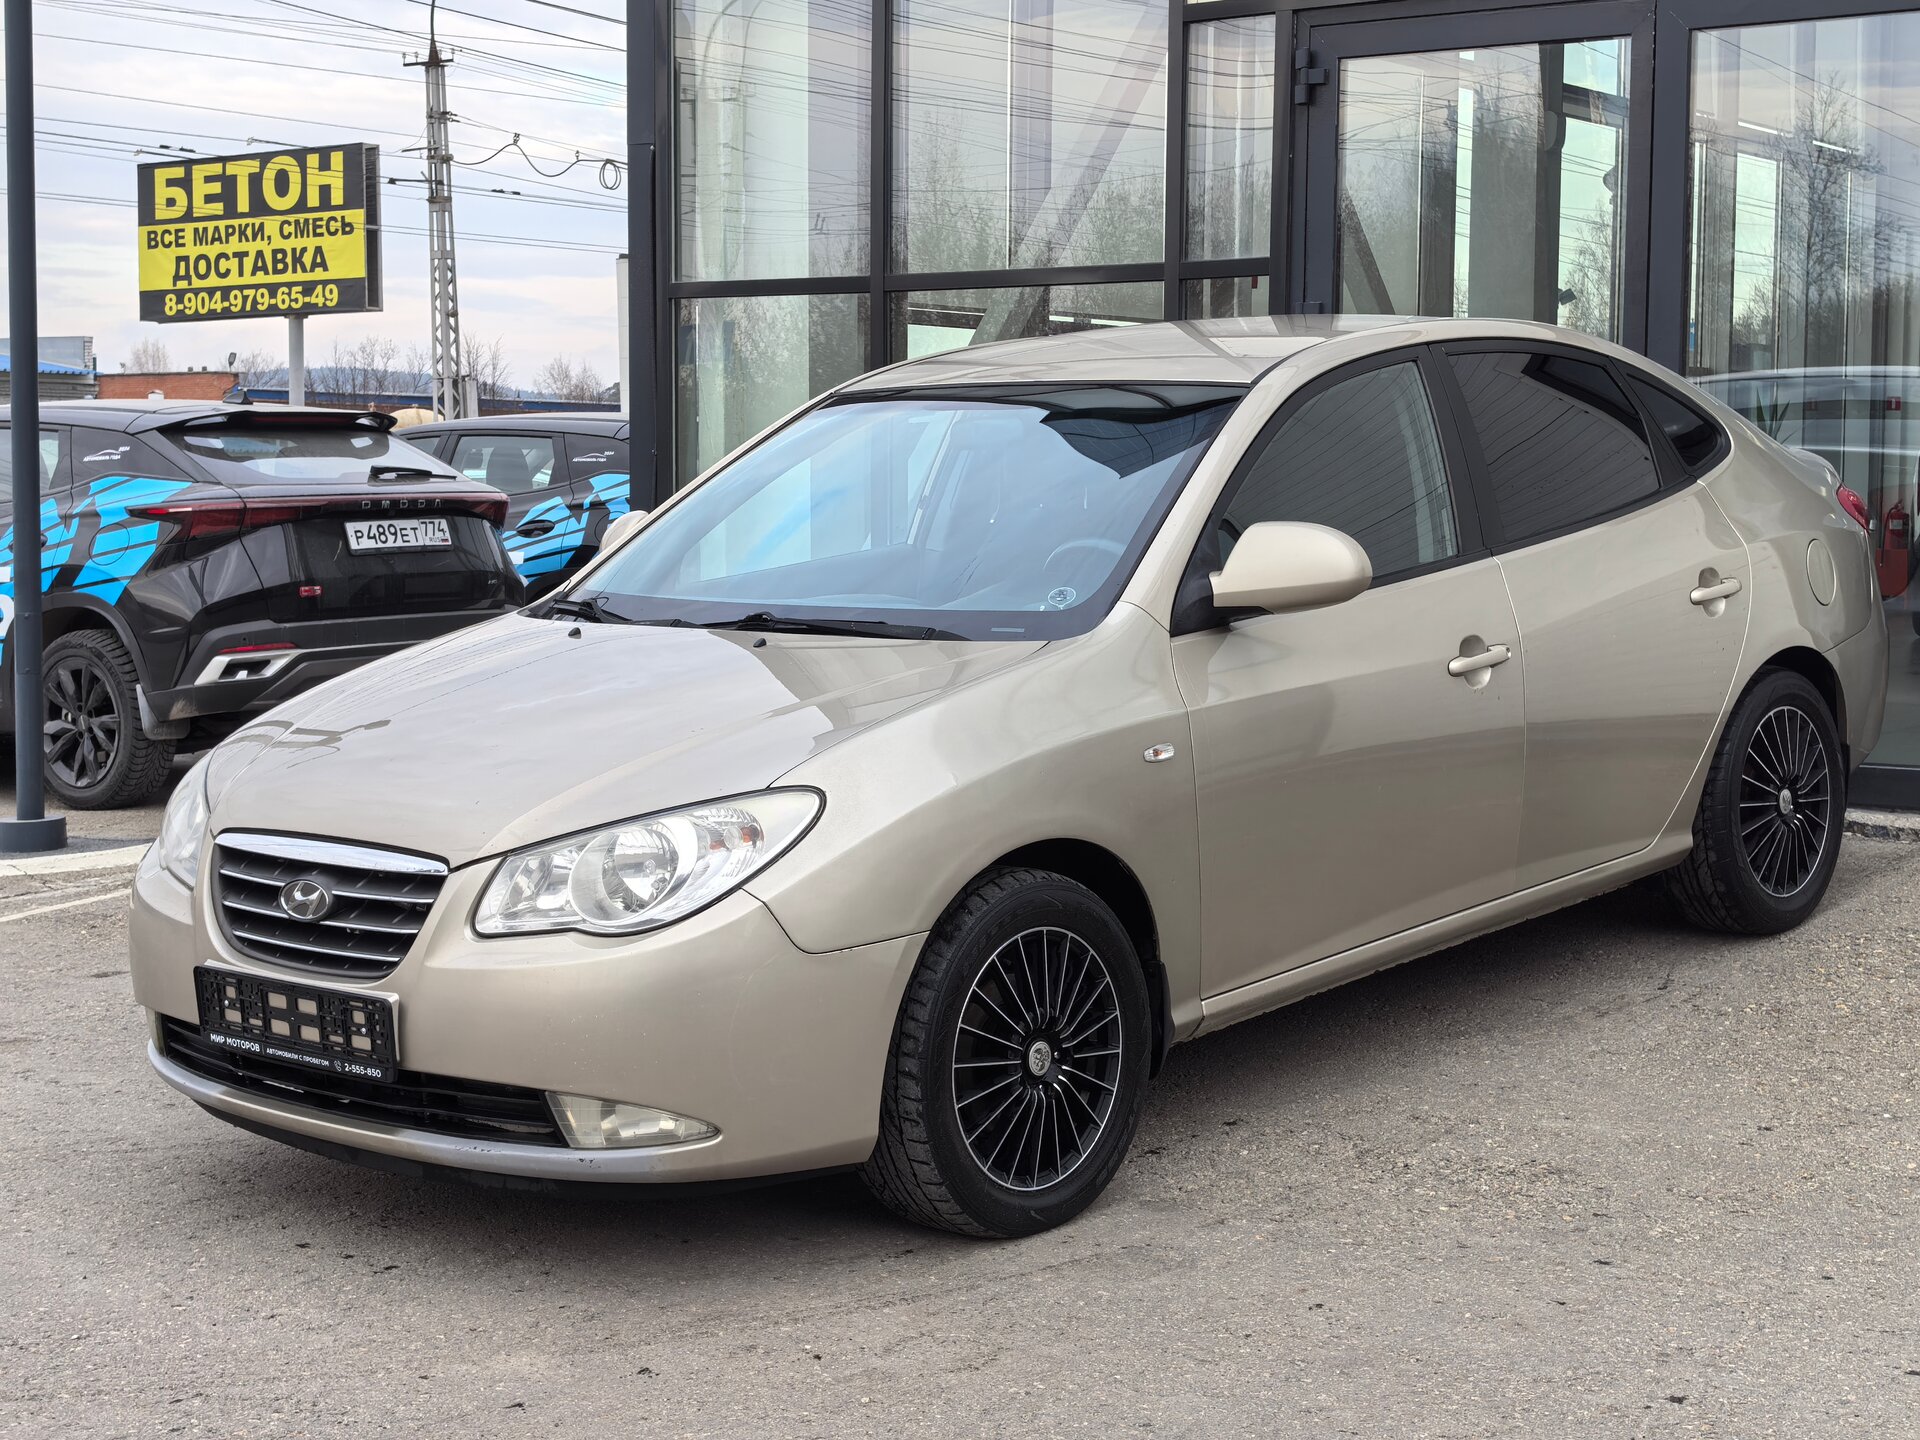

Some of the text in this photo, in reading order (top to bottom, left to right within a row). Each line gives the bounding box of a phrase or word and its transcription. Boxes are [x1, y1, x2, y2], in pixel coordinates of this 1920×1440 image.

[154, 151, 344, 220] БЕТОН
[147, 215, 355, 249] ВСЕ МАРКИ, СМЕСЬ
[172, 246, 329, 287] ДОСТАВКА
[164, 284, 339, 316] 8-904-979-65-49
[210, 1033, 226, 1044] МИР
[226, 1037, 261, 1053] МОТОРОВ
[266, 1047, 299, 1060] АВТОМОБИЛИ
[302, 1055, 330, 1067] ПРОБЕГОМ
[344, 1063, 382, 1078] 2-555-850
